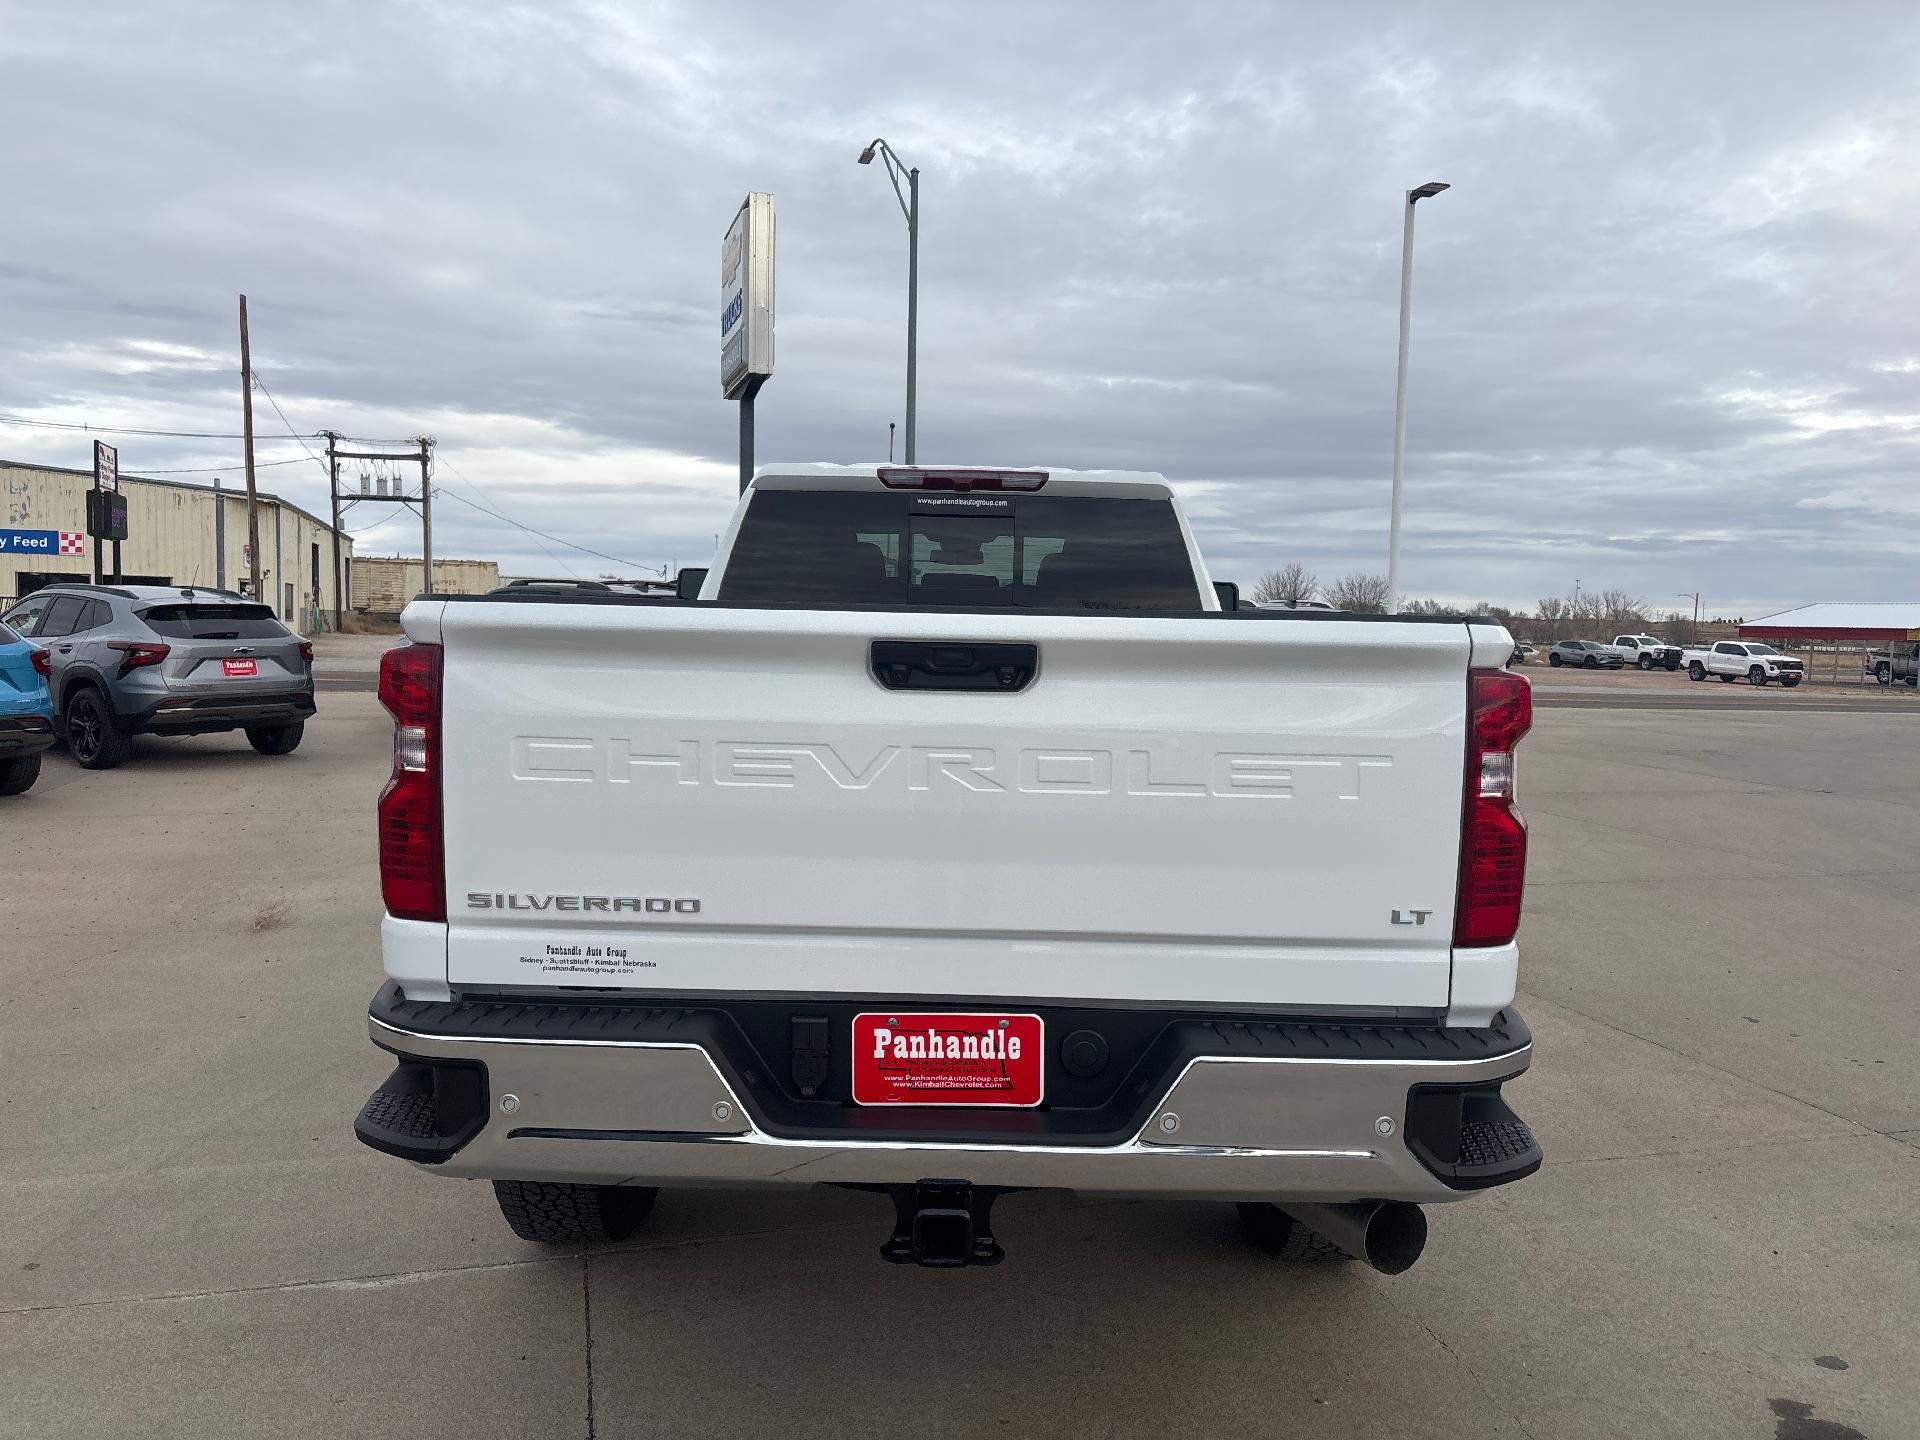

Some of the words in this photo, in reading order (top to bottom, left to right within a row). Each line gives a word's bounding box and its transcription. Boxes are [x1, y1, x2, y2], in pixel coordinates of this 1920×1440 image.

[916, 497, 1008, 508] www.panhandleautogroup.com
[13, 535, 48, 548] Feed
[511, 735, 1394, 801] CHEVROLET
[467, 891, 701, 914] SILVERADO
[1391, 909, 1433, 925] LT
[546, 944, 582, 956] Panhandle
[586, 946, 602, 957] Auto
[606, 946, 627, 959] Group
[519, 956, 544, 965] Sidney
[622, 959, 657, 968] Nebraska
[542, 965, 634, 975] panhandleautogroup.com
[873, 1028, 1021, 1060] Panhandle
[884, 1074, 1011, 1083] www.PanhandleAutoGroup.com
[892, 1081, 1002, 1089] www.KimballChevrolet.com
